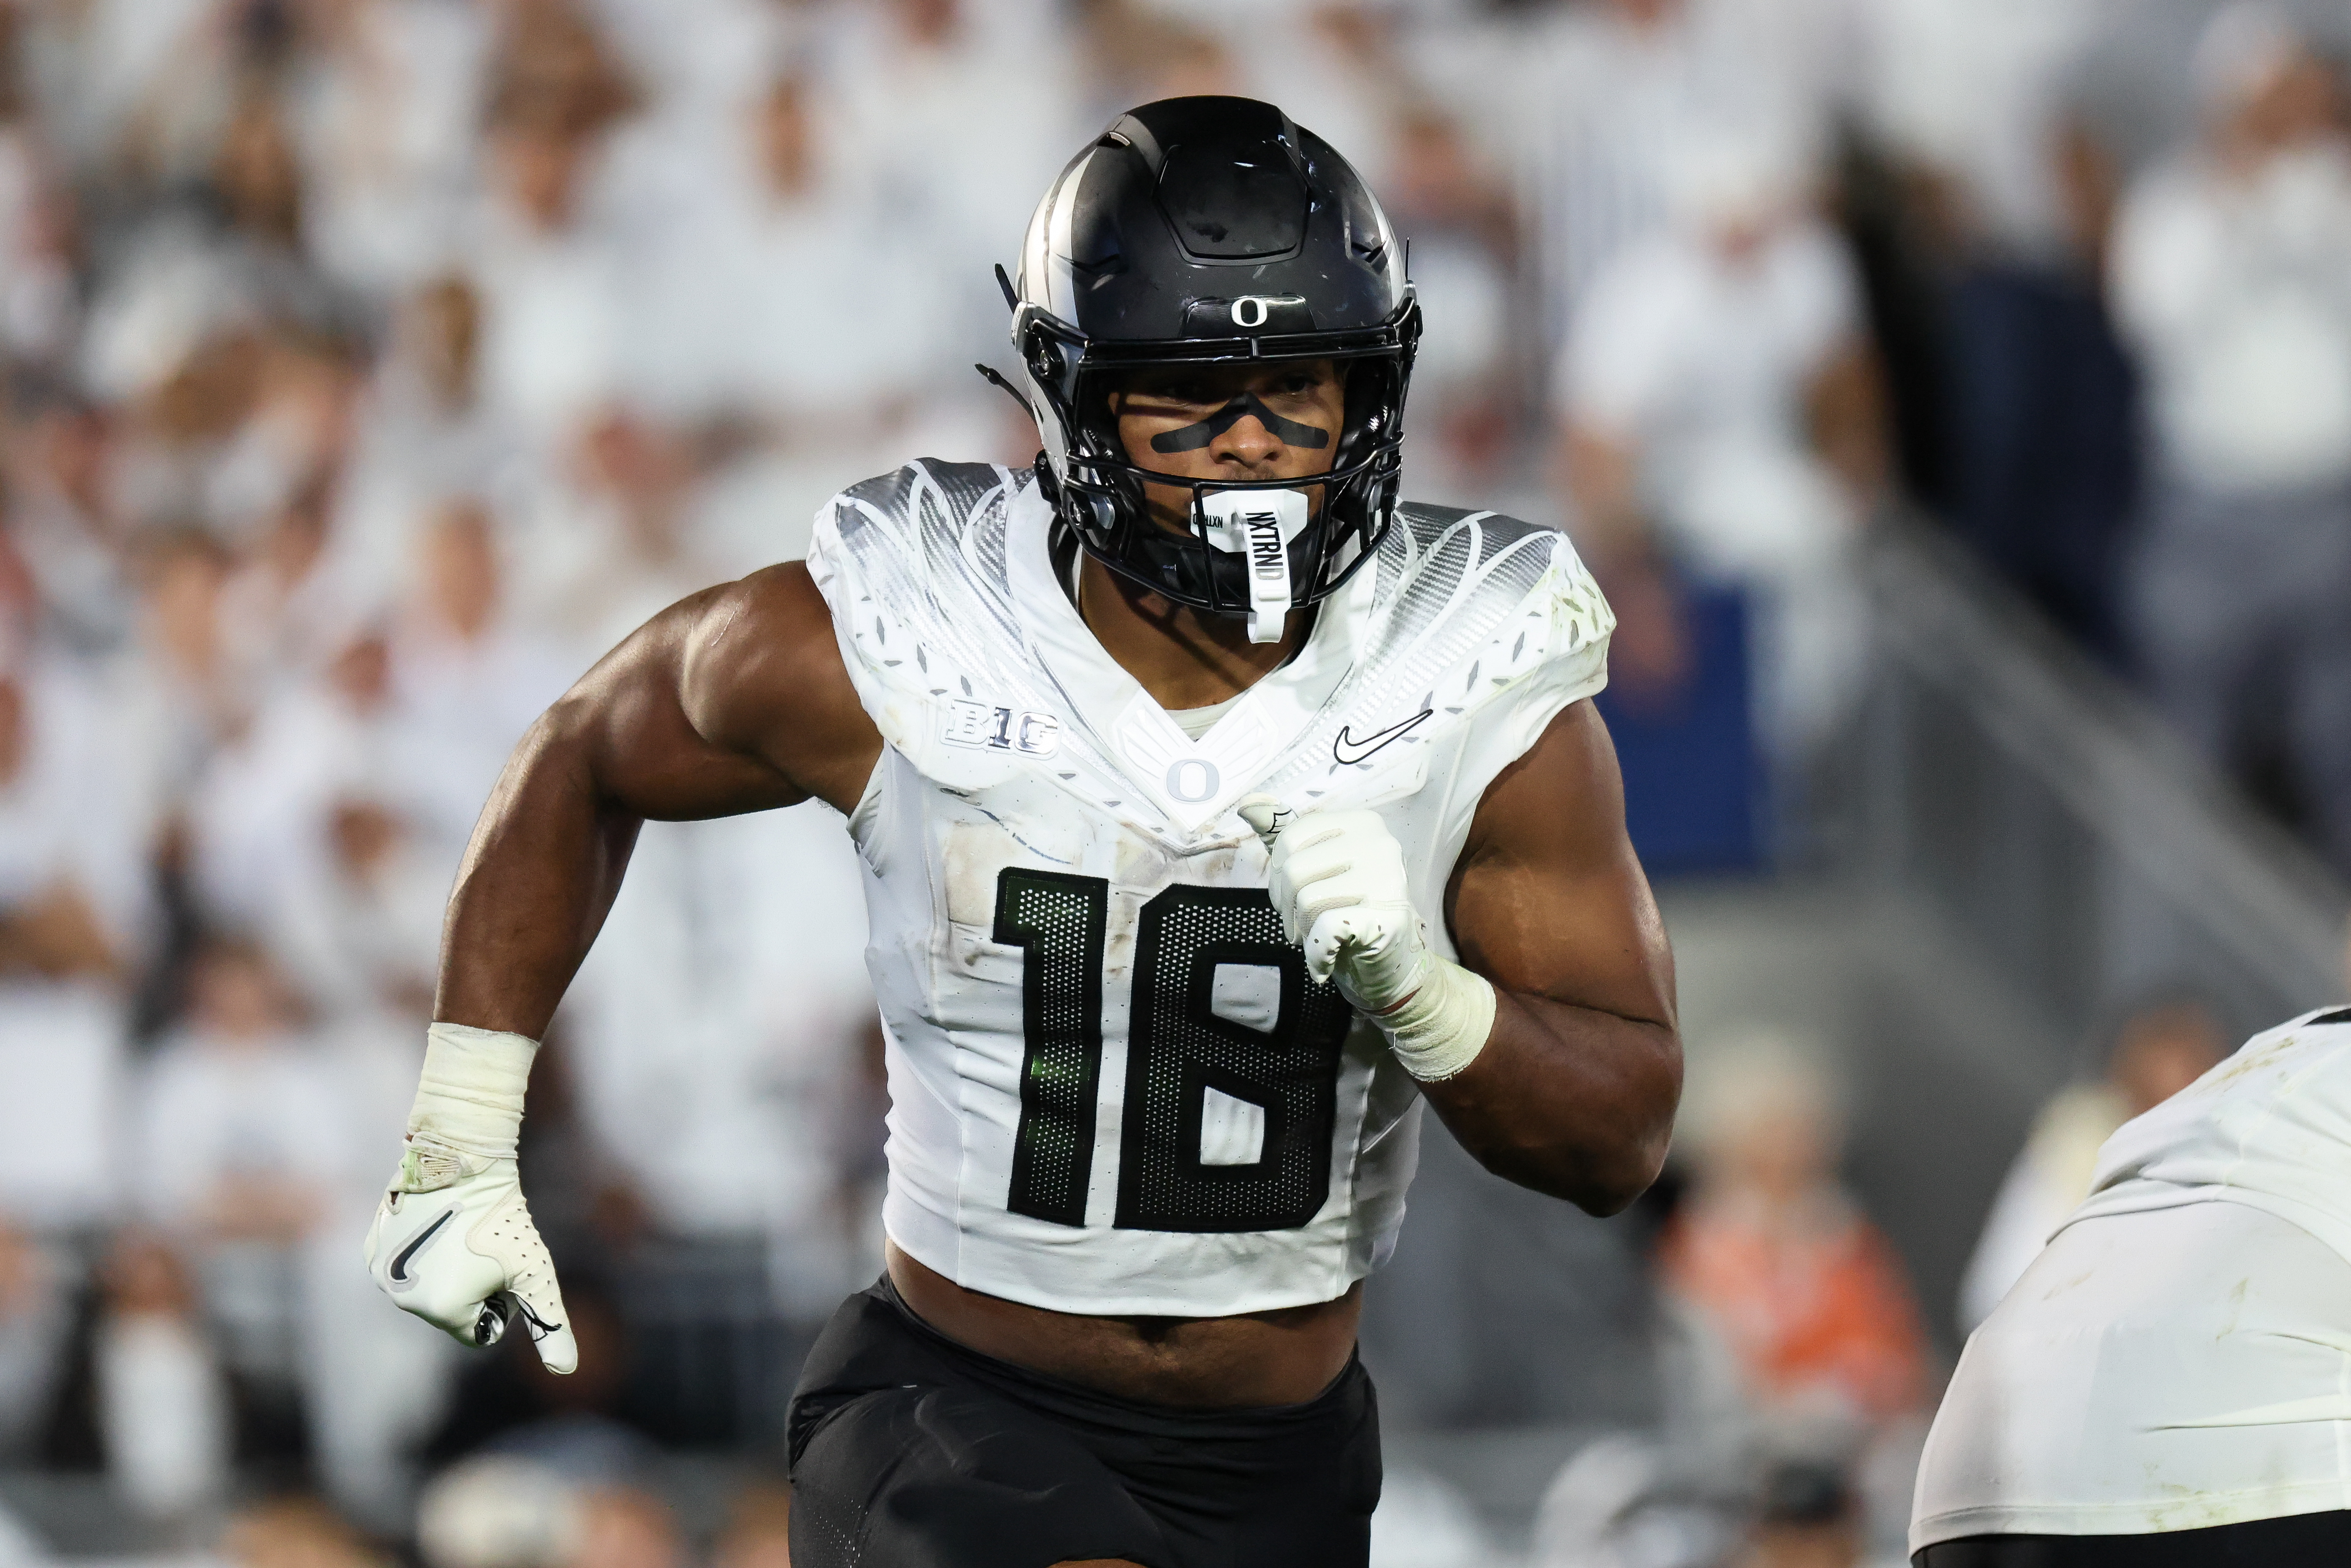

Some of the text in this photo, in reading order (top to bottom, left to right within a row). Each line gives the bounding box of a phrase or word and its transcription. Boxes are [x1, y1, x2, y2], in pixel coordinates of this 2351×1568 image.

[1231, 297, 1267, 327] O
[1193, 513, 1223, 529] NXTRD
[1245, 511, 1284, 580] NXTRND
[1166, 758, 1220, 803] O
[992, 866, 1353, 1234] 18
